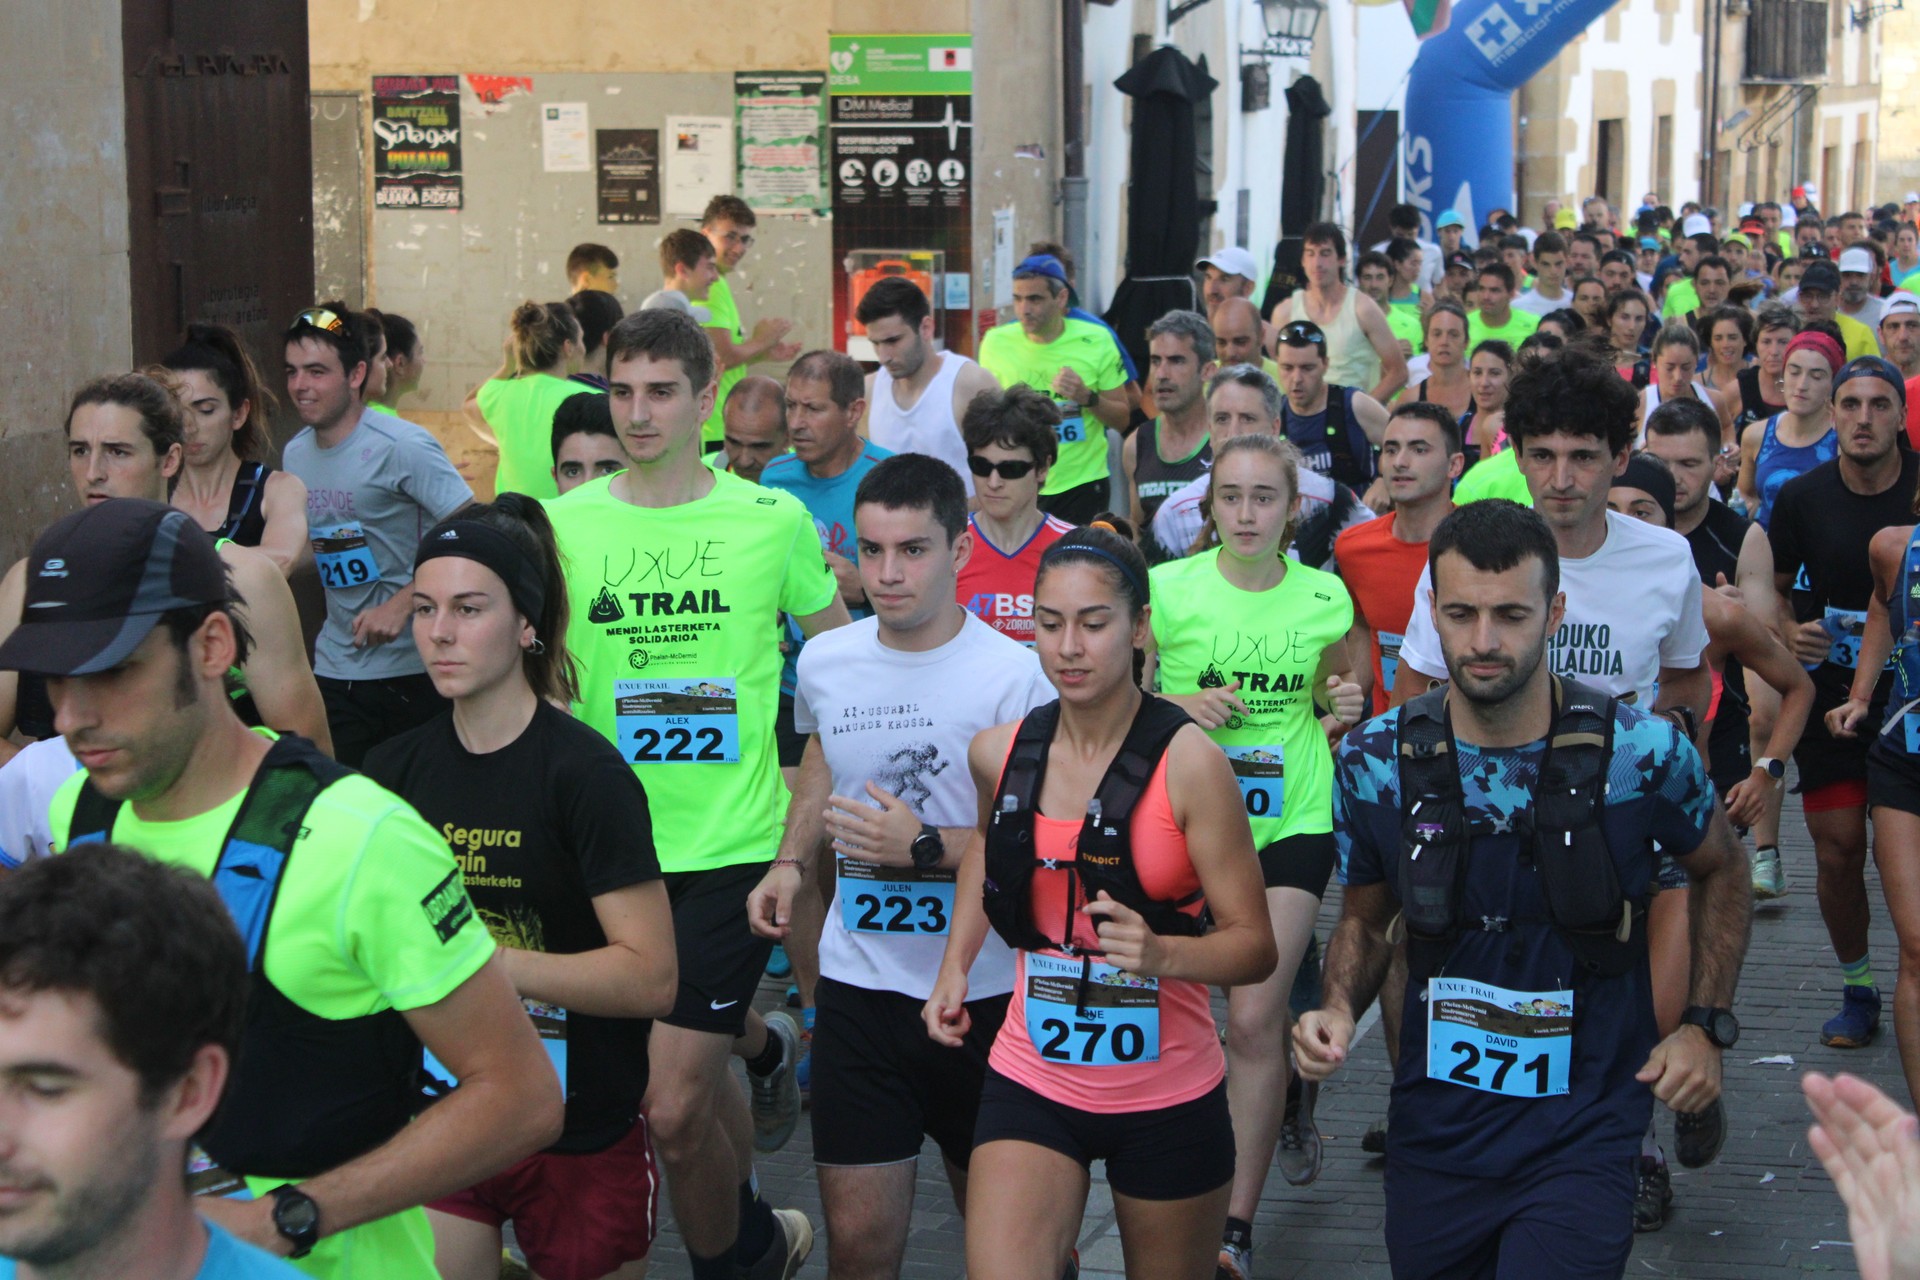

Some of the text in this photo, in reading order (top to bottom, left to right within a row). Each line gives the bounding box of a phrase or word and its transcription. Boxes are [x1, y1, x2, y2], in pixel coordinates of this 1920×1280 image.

[829, 75, 860, 85] DESA
[837, 97, 913, 111] IDM Medical
[321, 558, 369, 587] 219
[604, 540, 726, 589] UXUE
[629, 589, 731, 617] TRAIL
[606, 623, 721, 637] MENDI LASTERKETA
[629, 634, 698, 645] SOLIDARIOA
[1212, 630, 1308, 671] UXUE
[1232, 671, 1305, 693] TRAIL
[833, 718, 933, 735] BAXURDE KROSSA
[633, 728, 724, 761] 222
[1246, 788, 1270, 816] 0
[443, 822, 521, 851] Segura
[882, 884, 912, 892] JULEN
[855, 894, 947, 933] 223
[1438, 982, 1497, 999] UXUE TRAIL
[1041, 1018, 1145, 1062] 270
[1486, 1035, 1518, 1048] DAVID
[1449, 1041, 1549, 1094] 271
